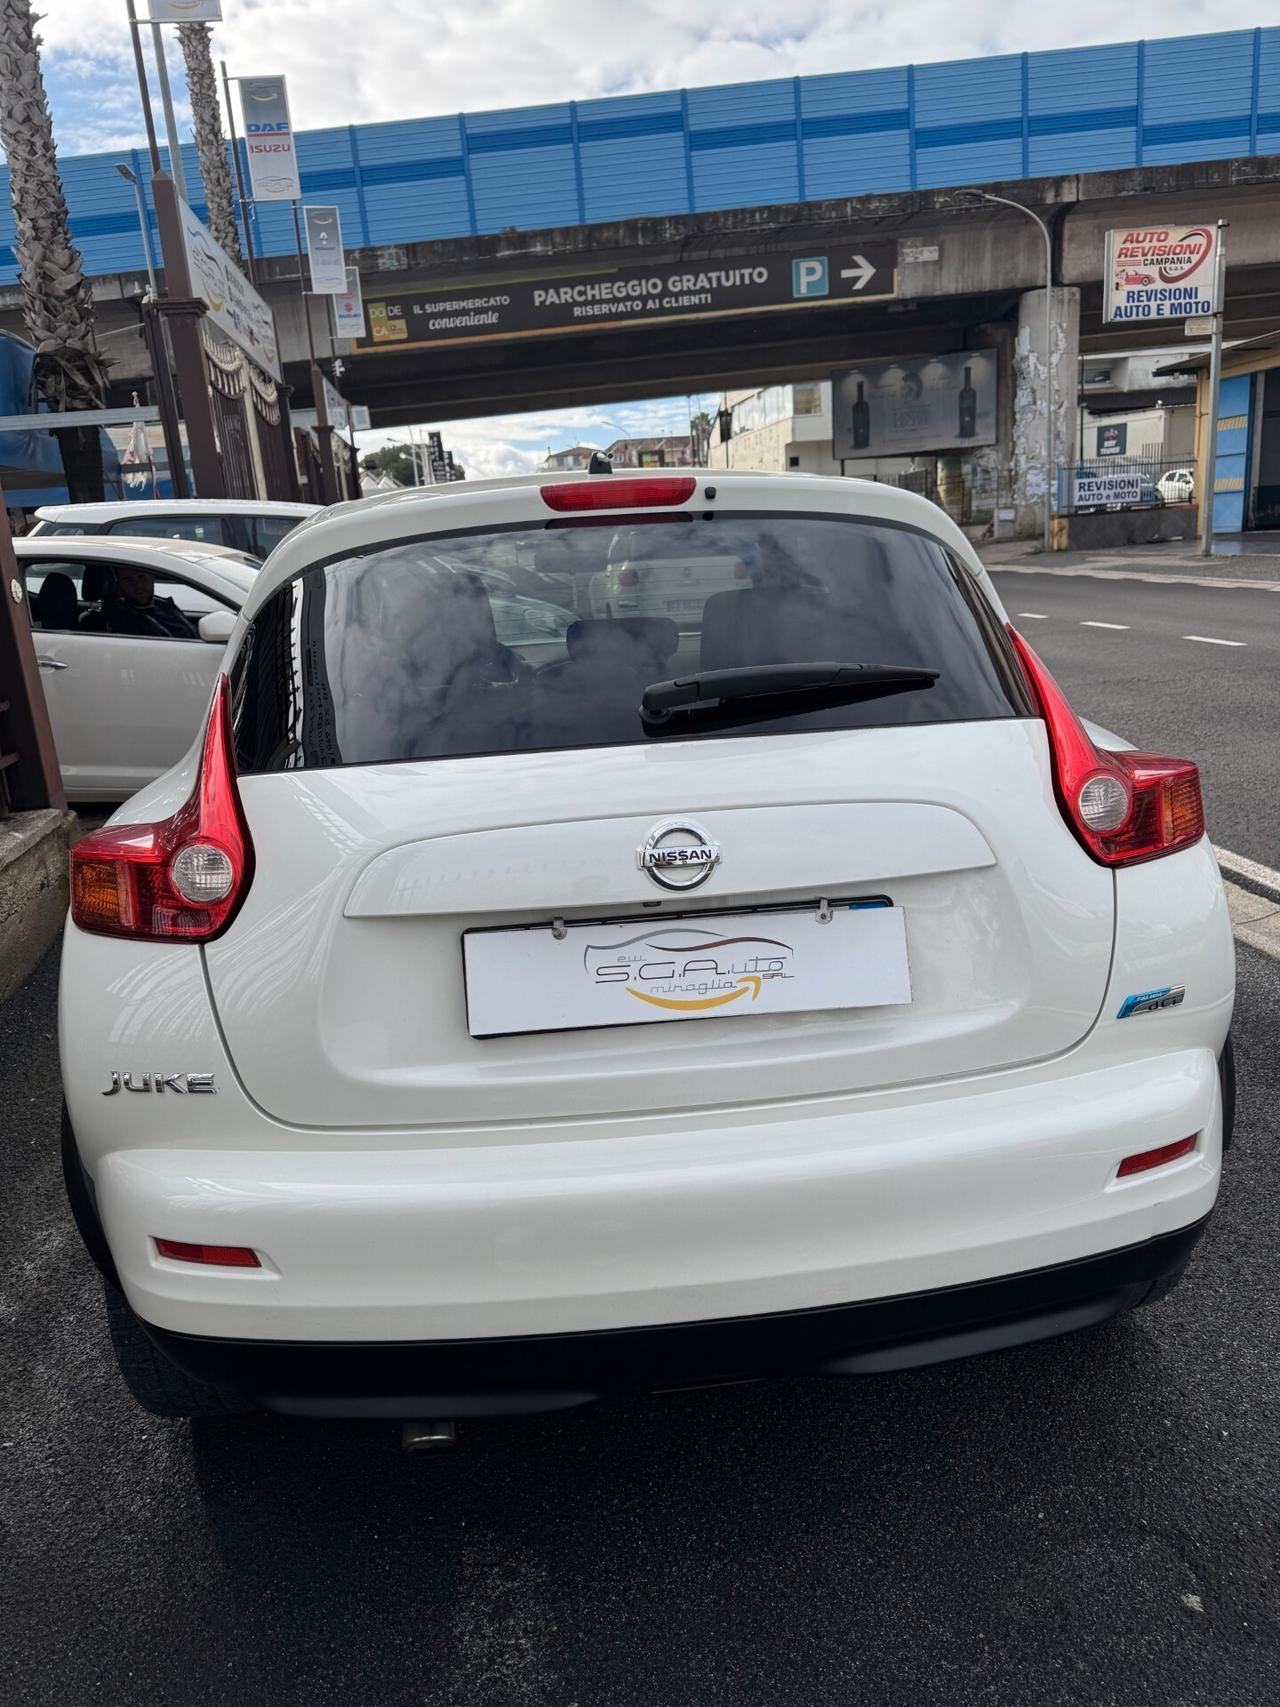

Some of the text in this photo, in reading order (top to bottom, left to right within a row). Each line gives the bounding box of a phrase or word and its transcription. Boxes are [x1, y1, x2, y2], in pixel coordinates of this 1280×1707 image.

[247, 122, 289, 132] DAF
[250, 144, 290, 153] ISUZU
[1122, 231, 1169, 244] AUTO
[1117, 243, 1203, 258] REVISIONI
[1143, 256, 1192, 266] CAMPANIA
[800, 261, 823, 294] P
[533, 266, 768, 306] PARCHEGGIO GRATUITO
[1126, 287, 1198, 303] REVISIONI
[413, 296, 510, 314] IL SUPERMERCATO
[573, 293, 712, 317] RISERVATO AI CLIENTI
[1114, 301, 1211, 318] AUTO E MOTO
[429, 311, 500, 329] conveniente
[1078, 479, 1139, 493] REVISIONI
[1077, 493, 1103, 503] AUTO
[1113, 491, 1138, 500] MOTO
[649, 849, 712, 863] NISSAN
[650, 979, 737, 994] miraglia
[101, 1071, 217, 1096] JUKE
